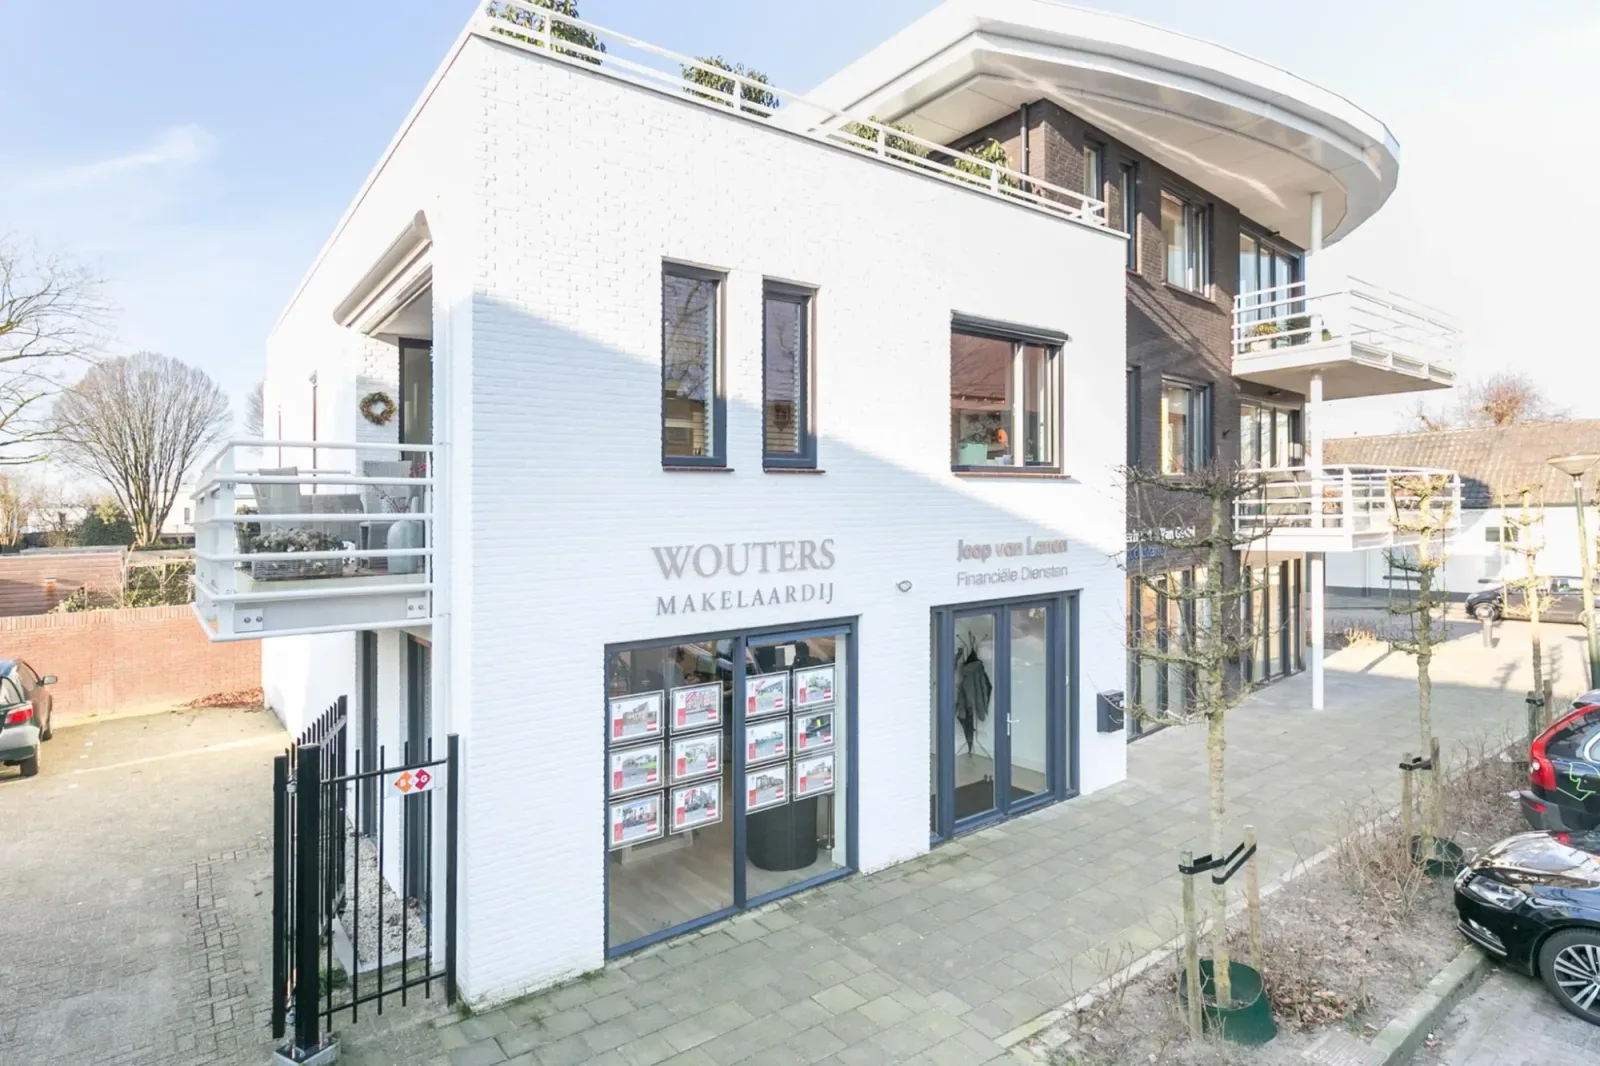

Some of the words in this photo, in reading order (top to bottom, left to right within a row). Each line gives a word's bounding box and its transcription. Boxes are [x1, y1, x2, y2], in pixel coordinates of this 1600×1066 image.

[651, 539, 835, 580] WOUTERS
[957, 539, 992, 563] Joop
[995, 542, 1023, 557] van
[957, 568, 1018, 586] Financiële
[1021, 565, 1068, 581] Diensten
[656, 582, 834, 616] MAKELAARDIJ
